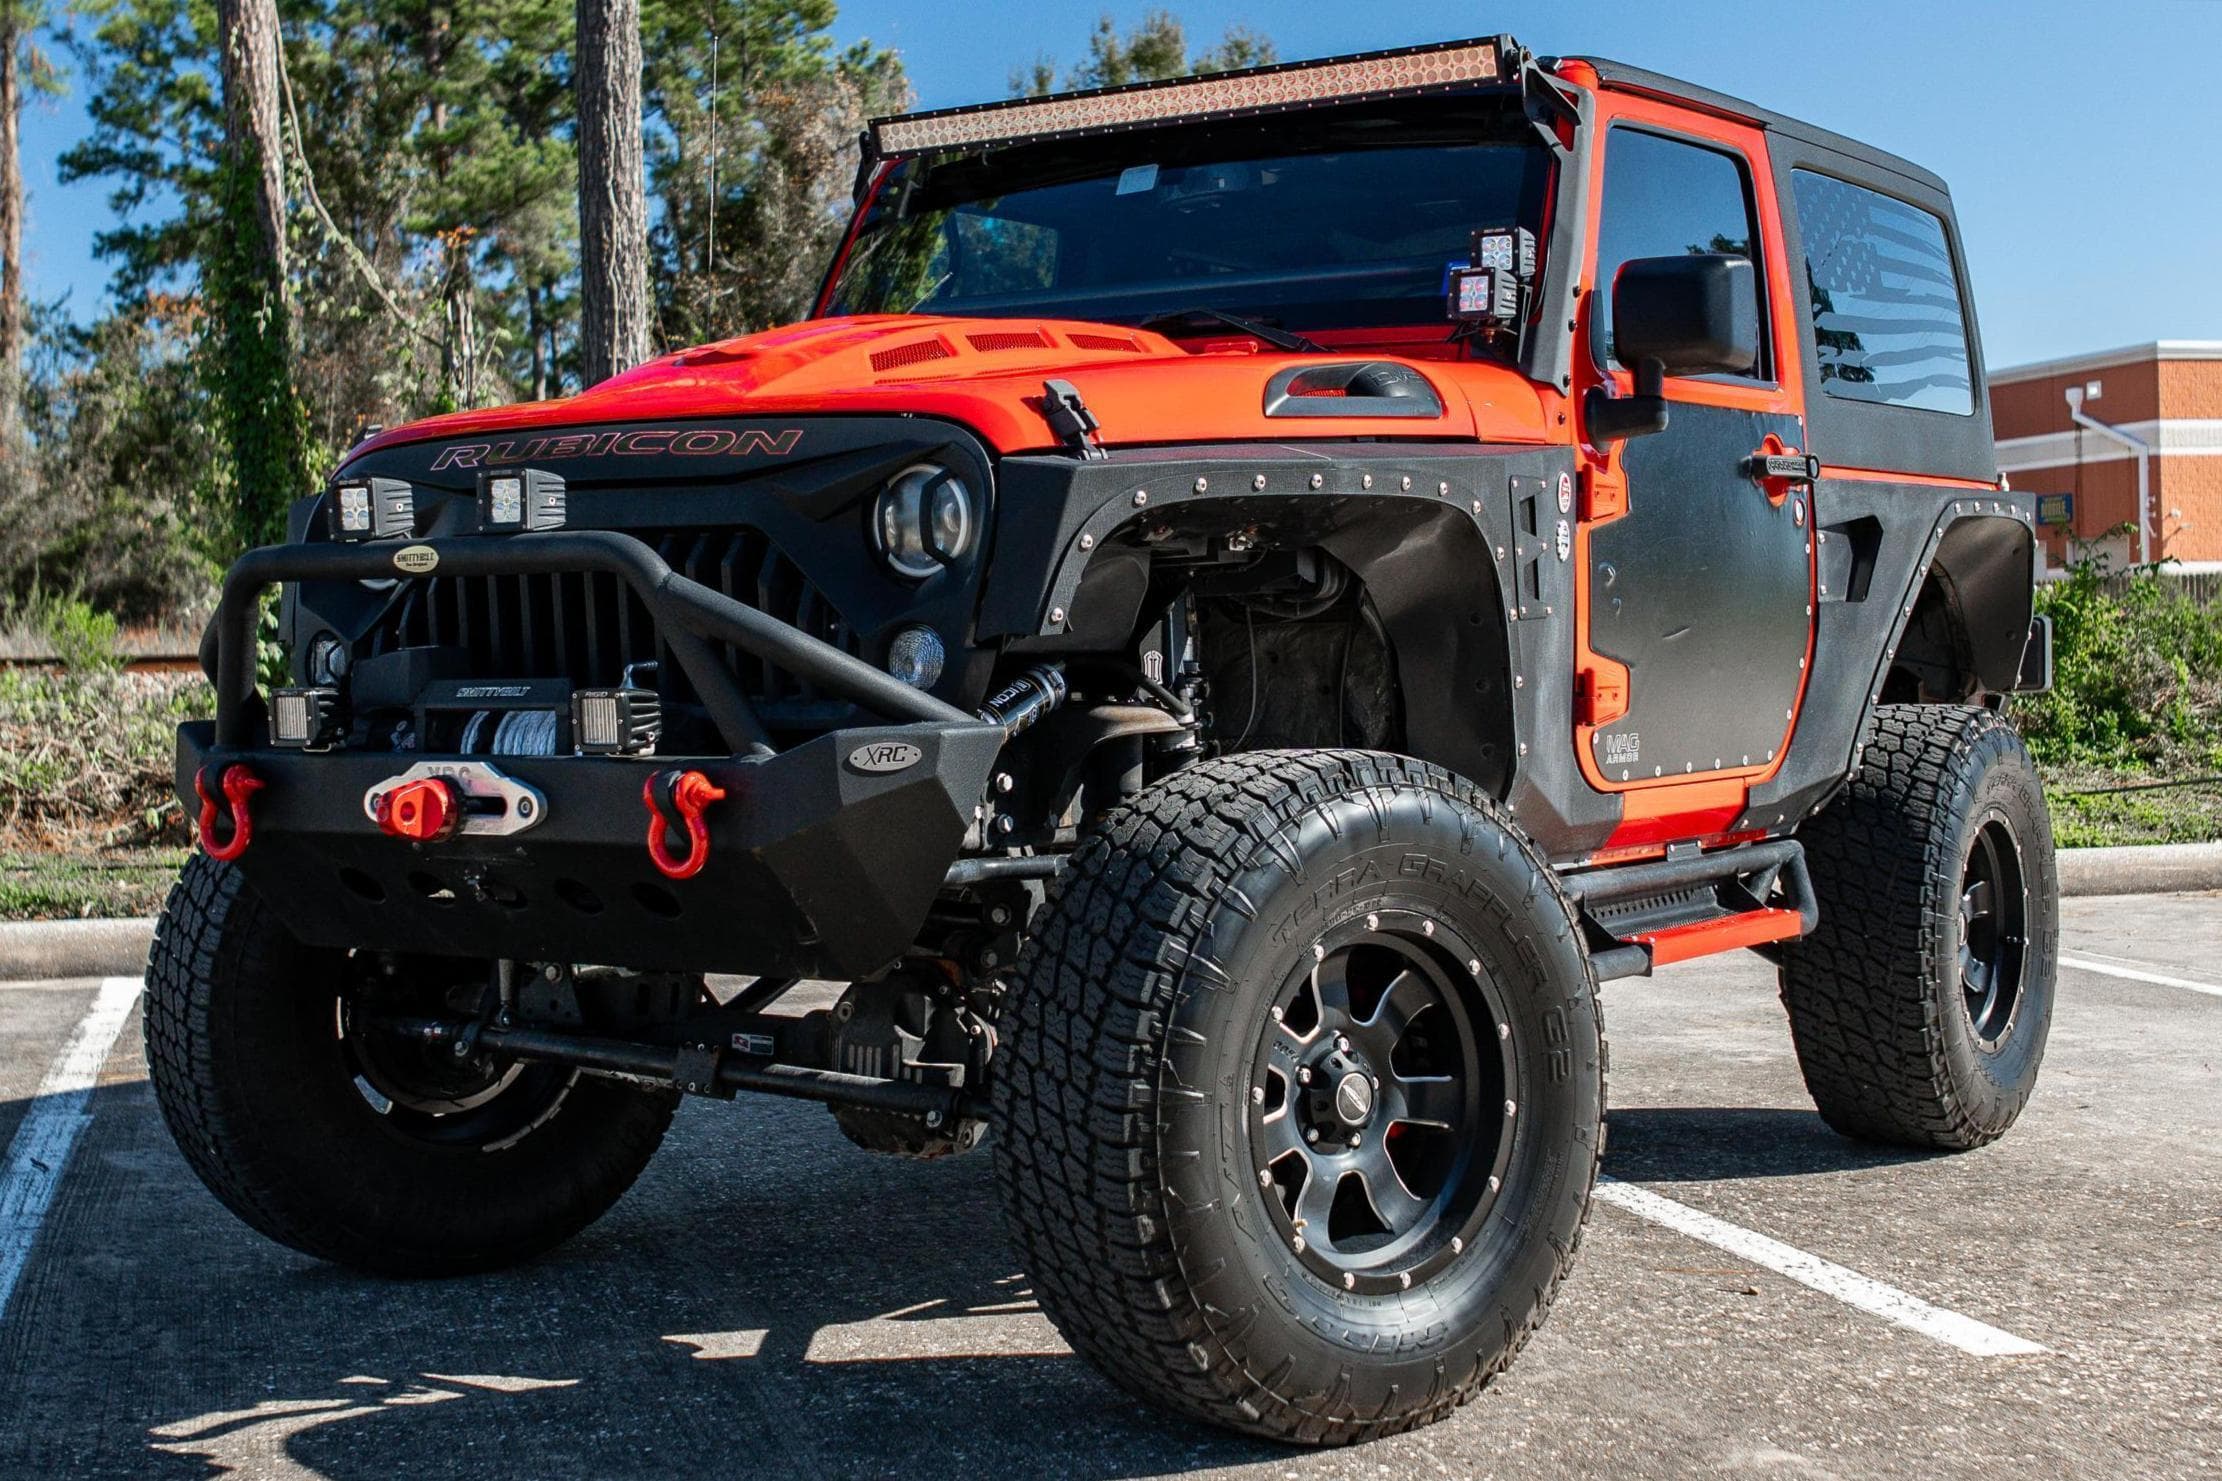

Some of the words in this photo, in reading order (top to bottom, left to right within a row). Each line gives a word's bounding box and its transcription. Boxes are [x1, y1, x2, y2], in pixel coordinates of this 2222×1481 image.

[430, 429, 803, 471] RUBICON
[456, 686, 531, 698] SMITTYBILT
[1606, 733, 1640, 753] MAG
[863, 745, 908, 766] XRC
[1542, 1005, 1571, 1083] G2
